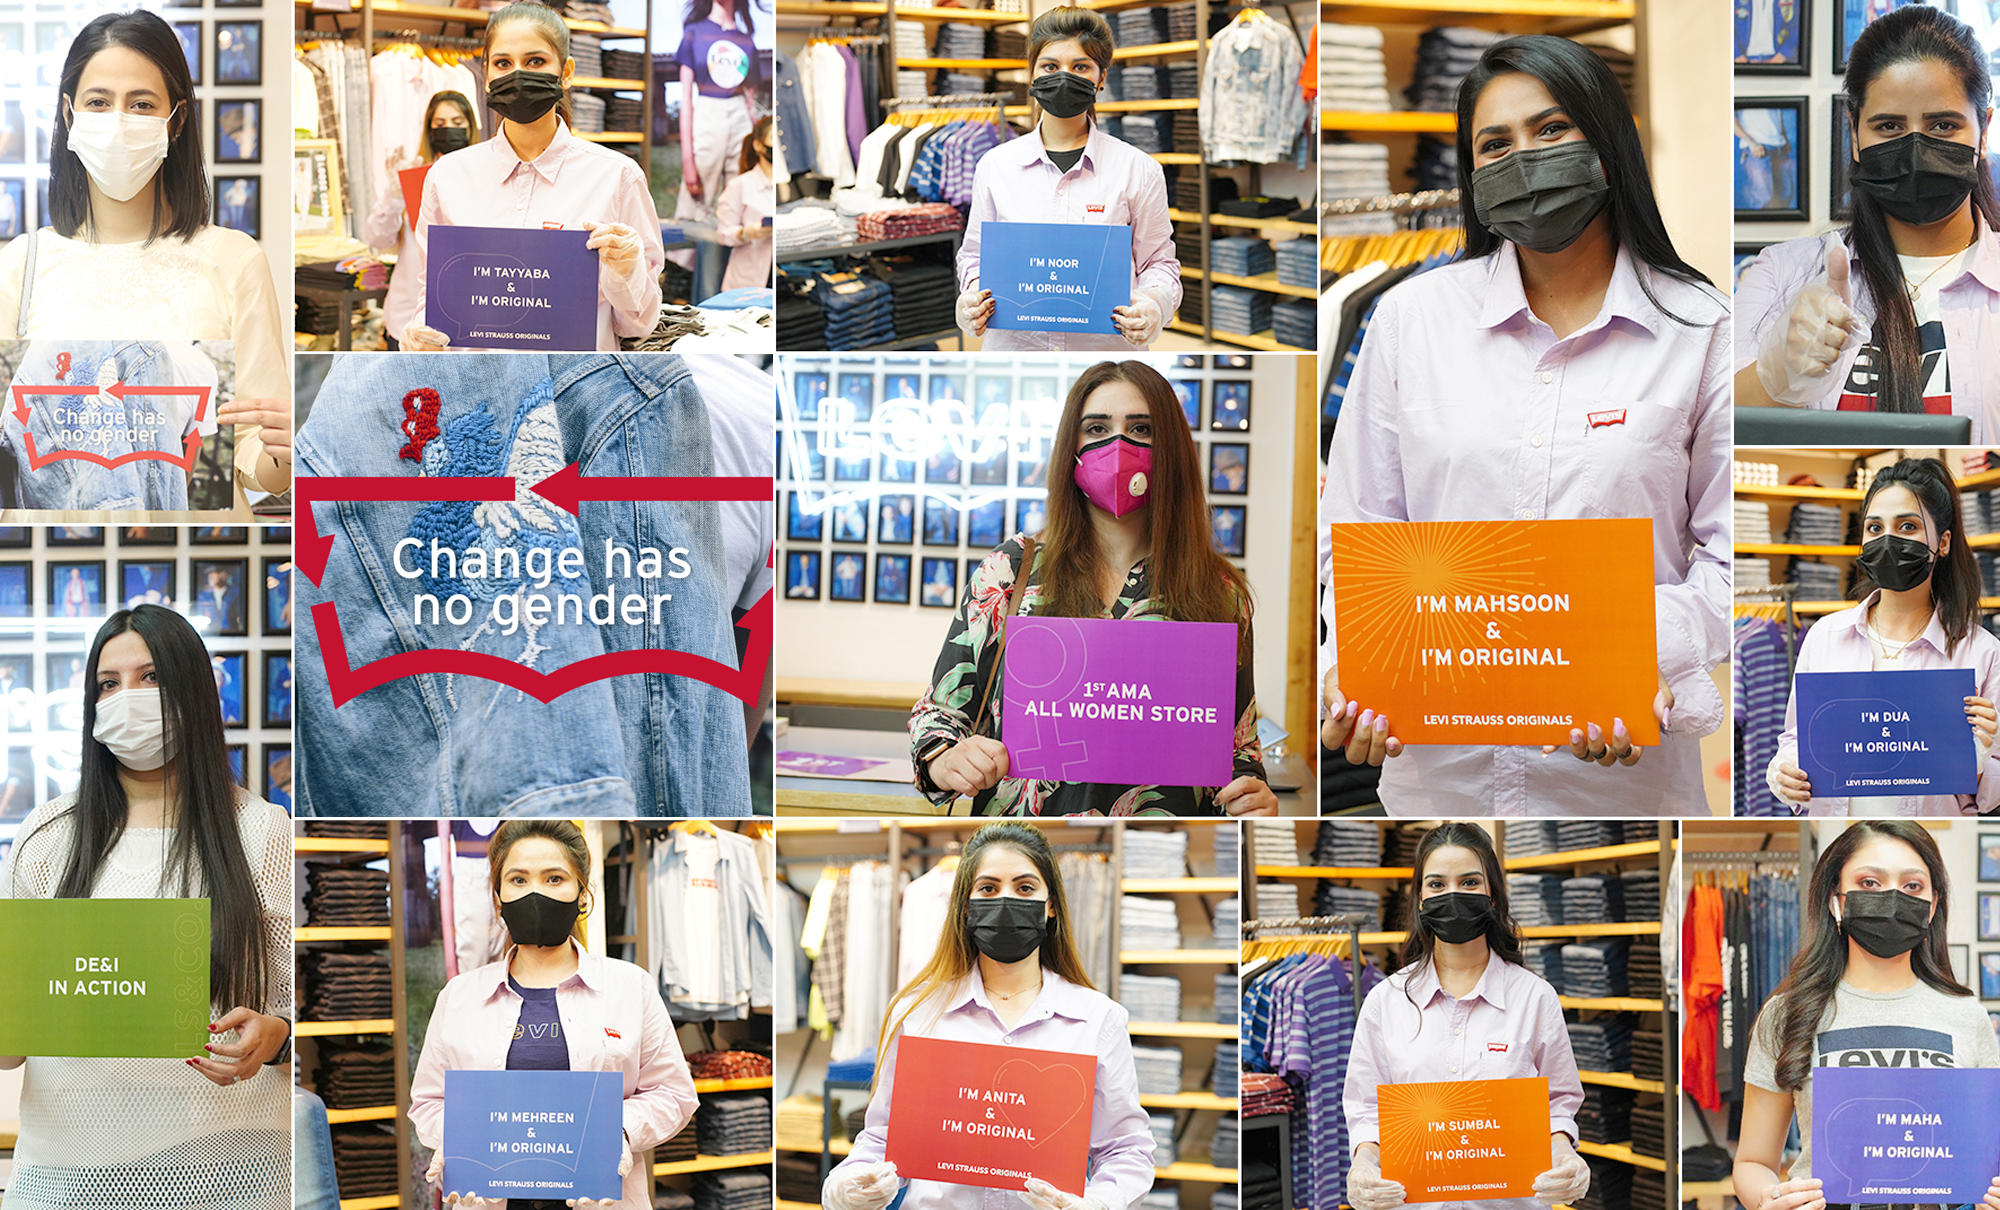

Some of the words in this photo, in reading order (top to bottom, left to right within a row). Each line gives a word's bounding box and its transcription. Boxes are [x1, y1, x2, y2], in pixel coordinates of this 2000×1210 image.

[1029, 257, 1045, 268] I'M
[1047, 258, 1080, 269] NOOR
[473, 266, 491, 277] I'M
[494, 267, 551, 279] TAYYABA
[1049, 270, 1058, 281] &
[506, 281, 516, 293] &
[1018, 282, 1034, 293] I'M
[1036, 283, 1090, 295] ORIGINAL
[471, 295, 489, 306] I'M
[491, 295, 552, 308] ORIGINAL
[1030, 315, 1057, 323] STRAUSS
[1056, 316, 1089, 324] ORIGINALS
[484, 331, 514, 339] STRAUSS
[514, 332, 551, 341] ORIGINALS
[53, 408, 126, 431] Change
[132, 408, 167, 425] has
[61, 429, 84, 442] no
[90, 426, 158, 446] gender
[1417, 595, 1446, 612] I'M
[1455, 594, 1569, 612] MAHSOON
[1486, 622, 1501, 639] &
[1422, 649, 1452, 665] I'M
[1460, 648, 1570, 665] ORIGINAL
[1107, 683, 1152, 699] AMA
[1025, 700, 1062, 717] ALL
[1069, 702, 1143, 720] WOMEN
[1151, 706, 1216, 723] STORE
[1861, 711, 1880, 723] I'M
[1882, 711, 1911, 723] DUA
[1423, 714, 1449, 725] LEVI
[1451, 714, 1505, 726] STRAUSS
[1506, 714, 1573, 726] ORIGINALS
[1881, 726, 1891, 738] &
[1845, 742, 1863, 753] I'M
[1866, 740, 1929, 753] ORIGINAL
[1845, 779, 1861, 787] LEVI
[1861, 778, 1892, 787] STRAUSS
[1892, 777, 1931, 786] ORIGINALS
[75, 957, 119, 973] DE&I
[174, 900, 204, 1052] LS&CO.
[49, 979, 68, 995] IN
[74, 980, 145, 995] ACTION
[958, 1087, 979, 1101] I'M
[983, 1090, 1025, 1105] ANITA
[490, 1111, 508, 1123] I'M
[511, 1111, 574, 1124] MEHREEN
[985, 1107, 995, 1120] &
[1877, 1113, 1897, 1125] I'M
[1900, 1113, 1943, 1126] MAHA
[942, 1119, 963, 1133] I'M
[967, 1123, 1035, 1140] ORIGINAL
[1428, 1121, 1446, 1132] I'M
[1448, 1118, 1501, 1132] SUMBAL
[526, 1127, 537, 1139] &
[1460, 1134, 1470, 1145] &
[1903, 1130, 1915, 1142] &
[489, 1141, 508, 1153] I'M
[511, 1142, 574, 1154] ORIGINAL
[1425, 1150, 1443, 1161] I'M
[1446, 1147, 1506, 1160] ORIGINAL
[1863, 1146, 1884, 1158] I'M
[1886, 1146, 1954, 1159] ORIGINAL
[937, 1161, 955, 1171] LEVI
[954, 1163, 989, 1175] STRAUSS
[990, 1167, 1032, 1180] ORIGINALS
[504, 1180, 535, 1188] STRAUSS
[535, 1180, 574, 1189] ORIGINALS
[1426, 1185, 1442, 1193] LEVI
[1441, 1184, 1471, 1192] STRAUSS
[1471, 1182, 1508, 1191] ORIGINALS
[1861, 1186, 1879, 1194] LEVI
[1878, 1187, 1912, 1195] STRAUSS
[1912, 1187, 1952, 1195] ORIGINALS
